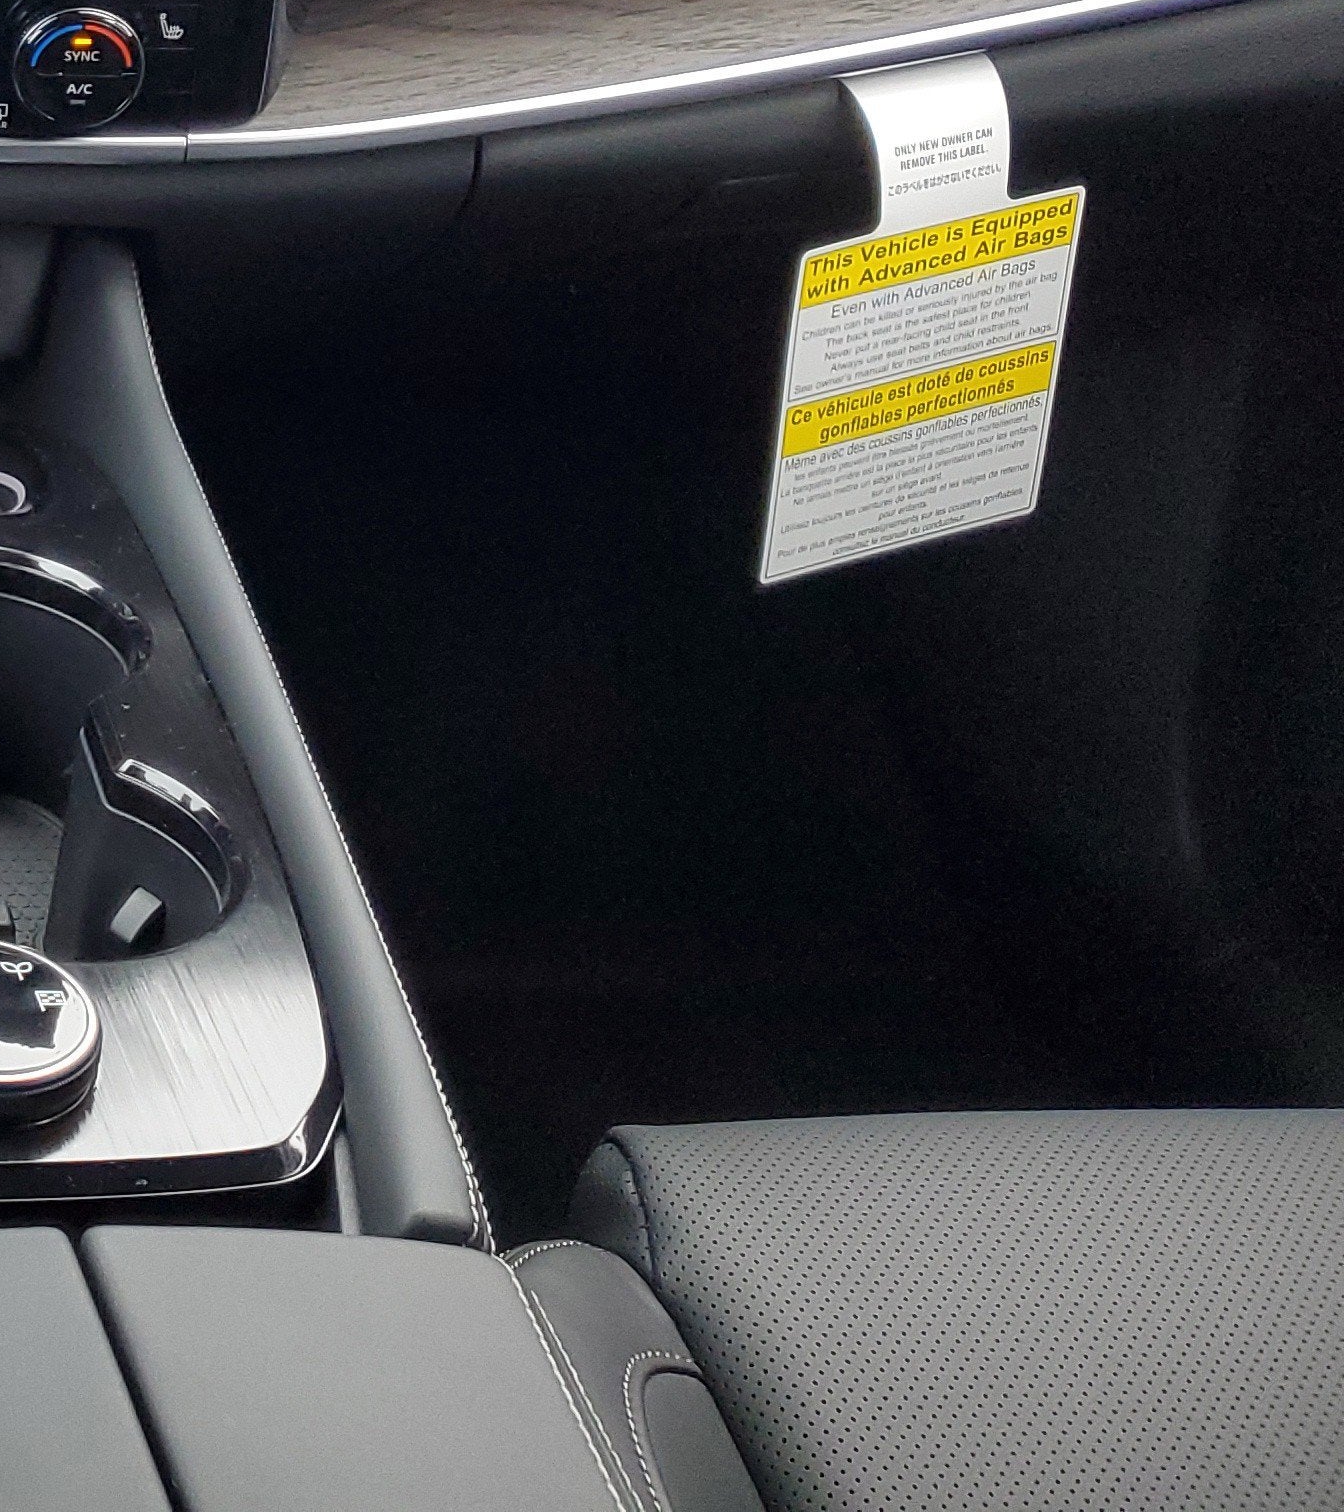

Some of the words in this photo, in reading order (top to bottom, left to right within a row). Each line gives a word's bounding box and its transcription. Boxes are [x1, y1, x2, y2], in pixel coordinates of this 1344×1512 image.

[64, 51, 100, 63] SYNC
[66, 83, 92, 95] A/C
[895, 144, 916, 157] ONLY
[920, 138, 938, 151] NEW
[942, 132, 973, 147] OWNER
[975, 127, 992, 139] CAN
[900, 154, 935, 171] REMOVE
[938, 150, 957, 161] THIS
[807, 275, 849, 300] with
[858, 249, 966, 286] Advanced
[974, 238, 1007, 258] Air
[1014, 223, 1068, 248] Bags
[811, 254, 853, 277] This
[861, 231, 939, 262] Vehicle
[946, 225, 963, 242] is
[971, 198, 1073, 236] Equipped
[831, 303, 867, 319] Even
[871, 292, 899, 309] with
[904, 276, 973, 301] Advanced
[977, 266, 997, 282] Air
[1001, 258, 1036, 278] Bags
[791, 409, 812, 425] Ce
[817, 392, 883, 419] véhicule
[888, 385, 912, 400] est
[916, 373, 950, 393] doté
[955, 367, 974, 383] de
[978, 349, 1049, 377] coussins
[819, 405, 902, 443] gonflables
[906, 378, 1015, 420] perfectionnés
